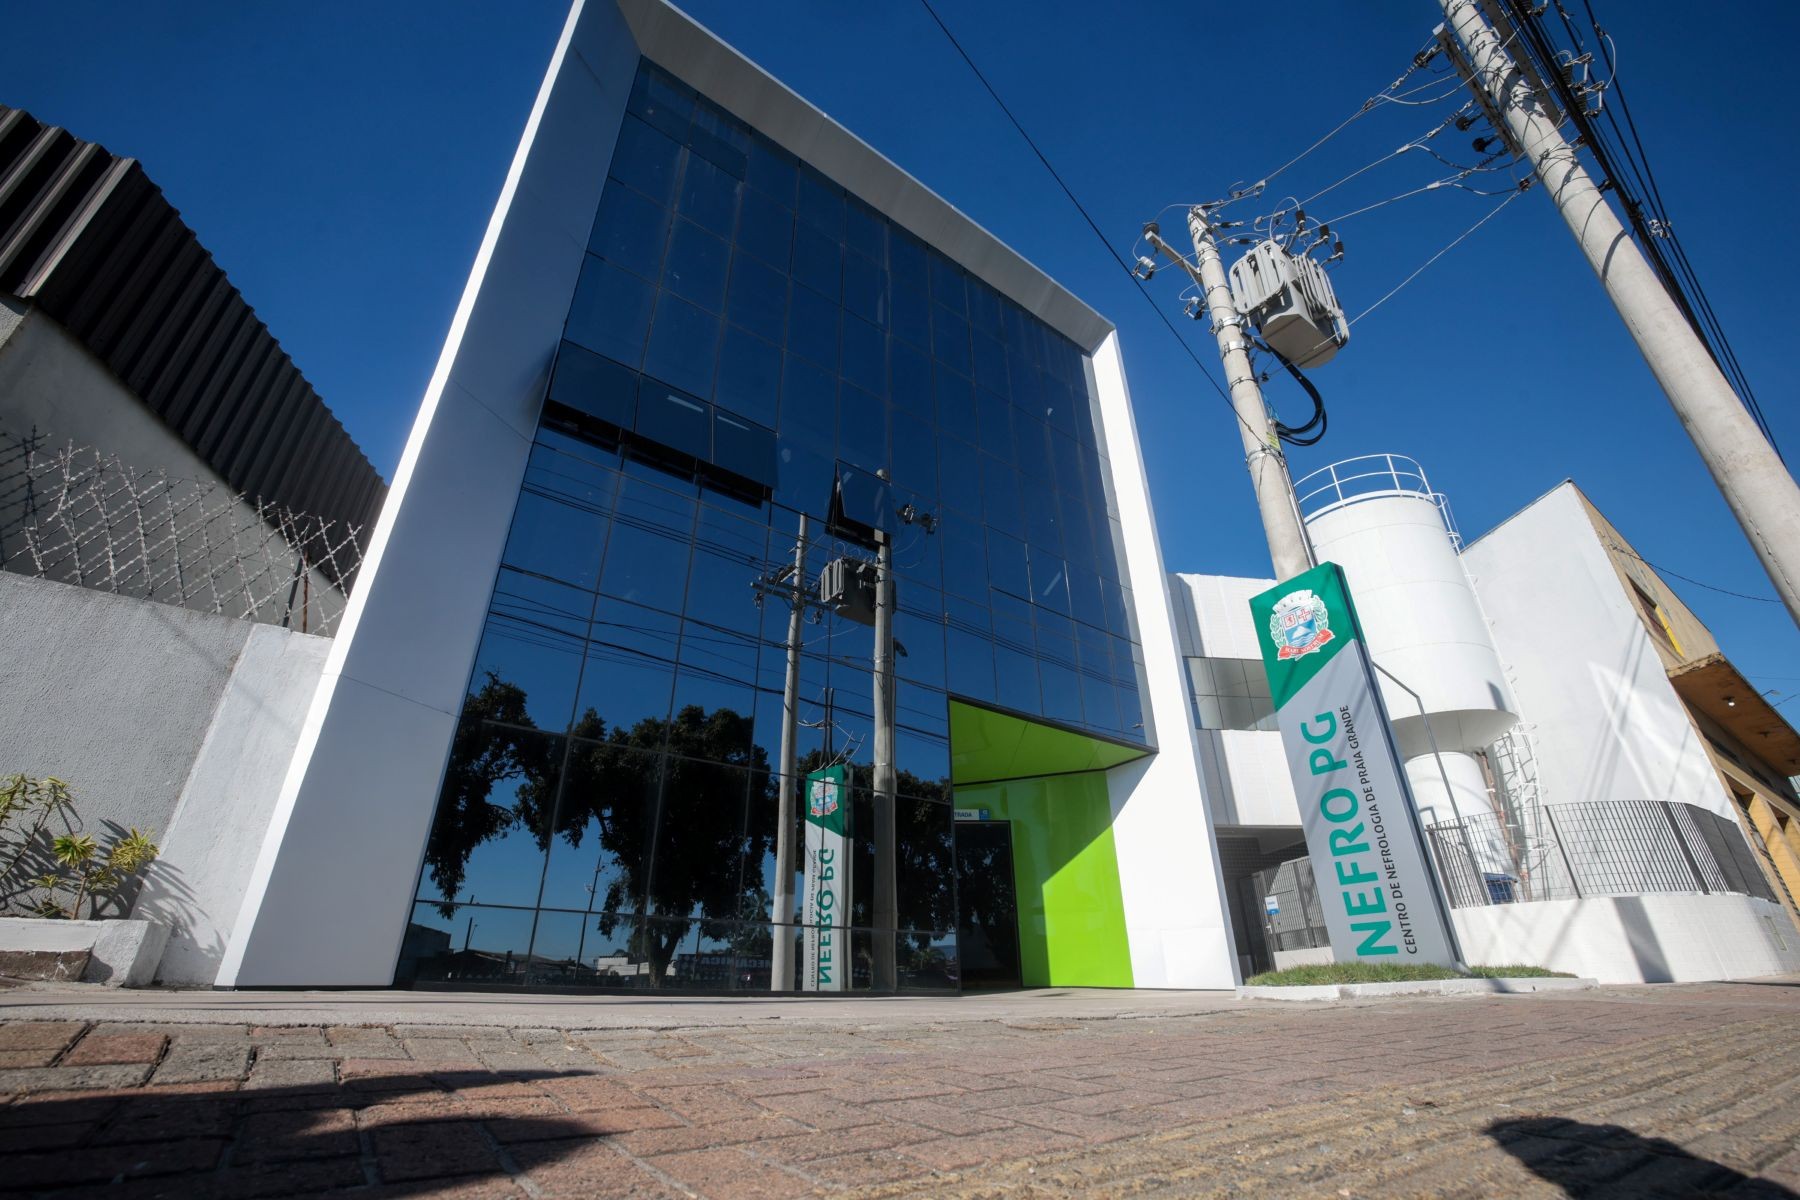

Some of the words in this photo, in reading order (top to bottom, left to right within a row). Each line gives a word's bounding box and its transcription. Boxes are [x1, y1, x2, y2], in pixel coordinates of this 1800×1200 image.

[1300, 711, 1348, 776] PG
[1340, 705, 1359, 750] GRANDE
[1353, 751, 1370, 784] PRAIA
[1362, 786, 1376, 802] DE
[1368, 804, 1398, 879] NEFROLOGIA
[1320, 788, 1399, 956] NEFRO
[1389, 882, 1403, 899] DE
[1395, 902, 1418, 954] CENTRO
